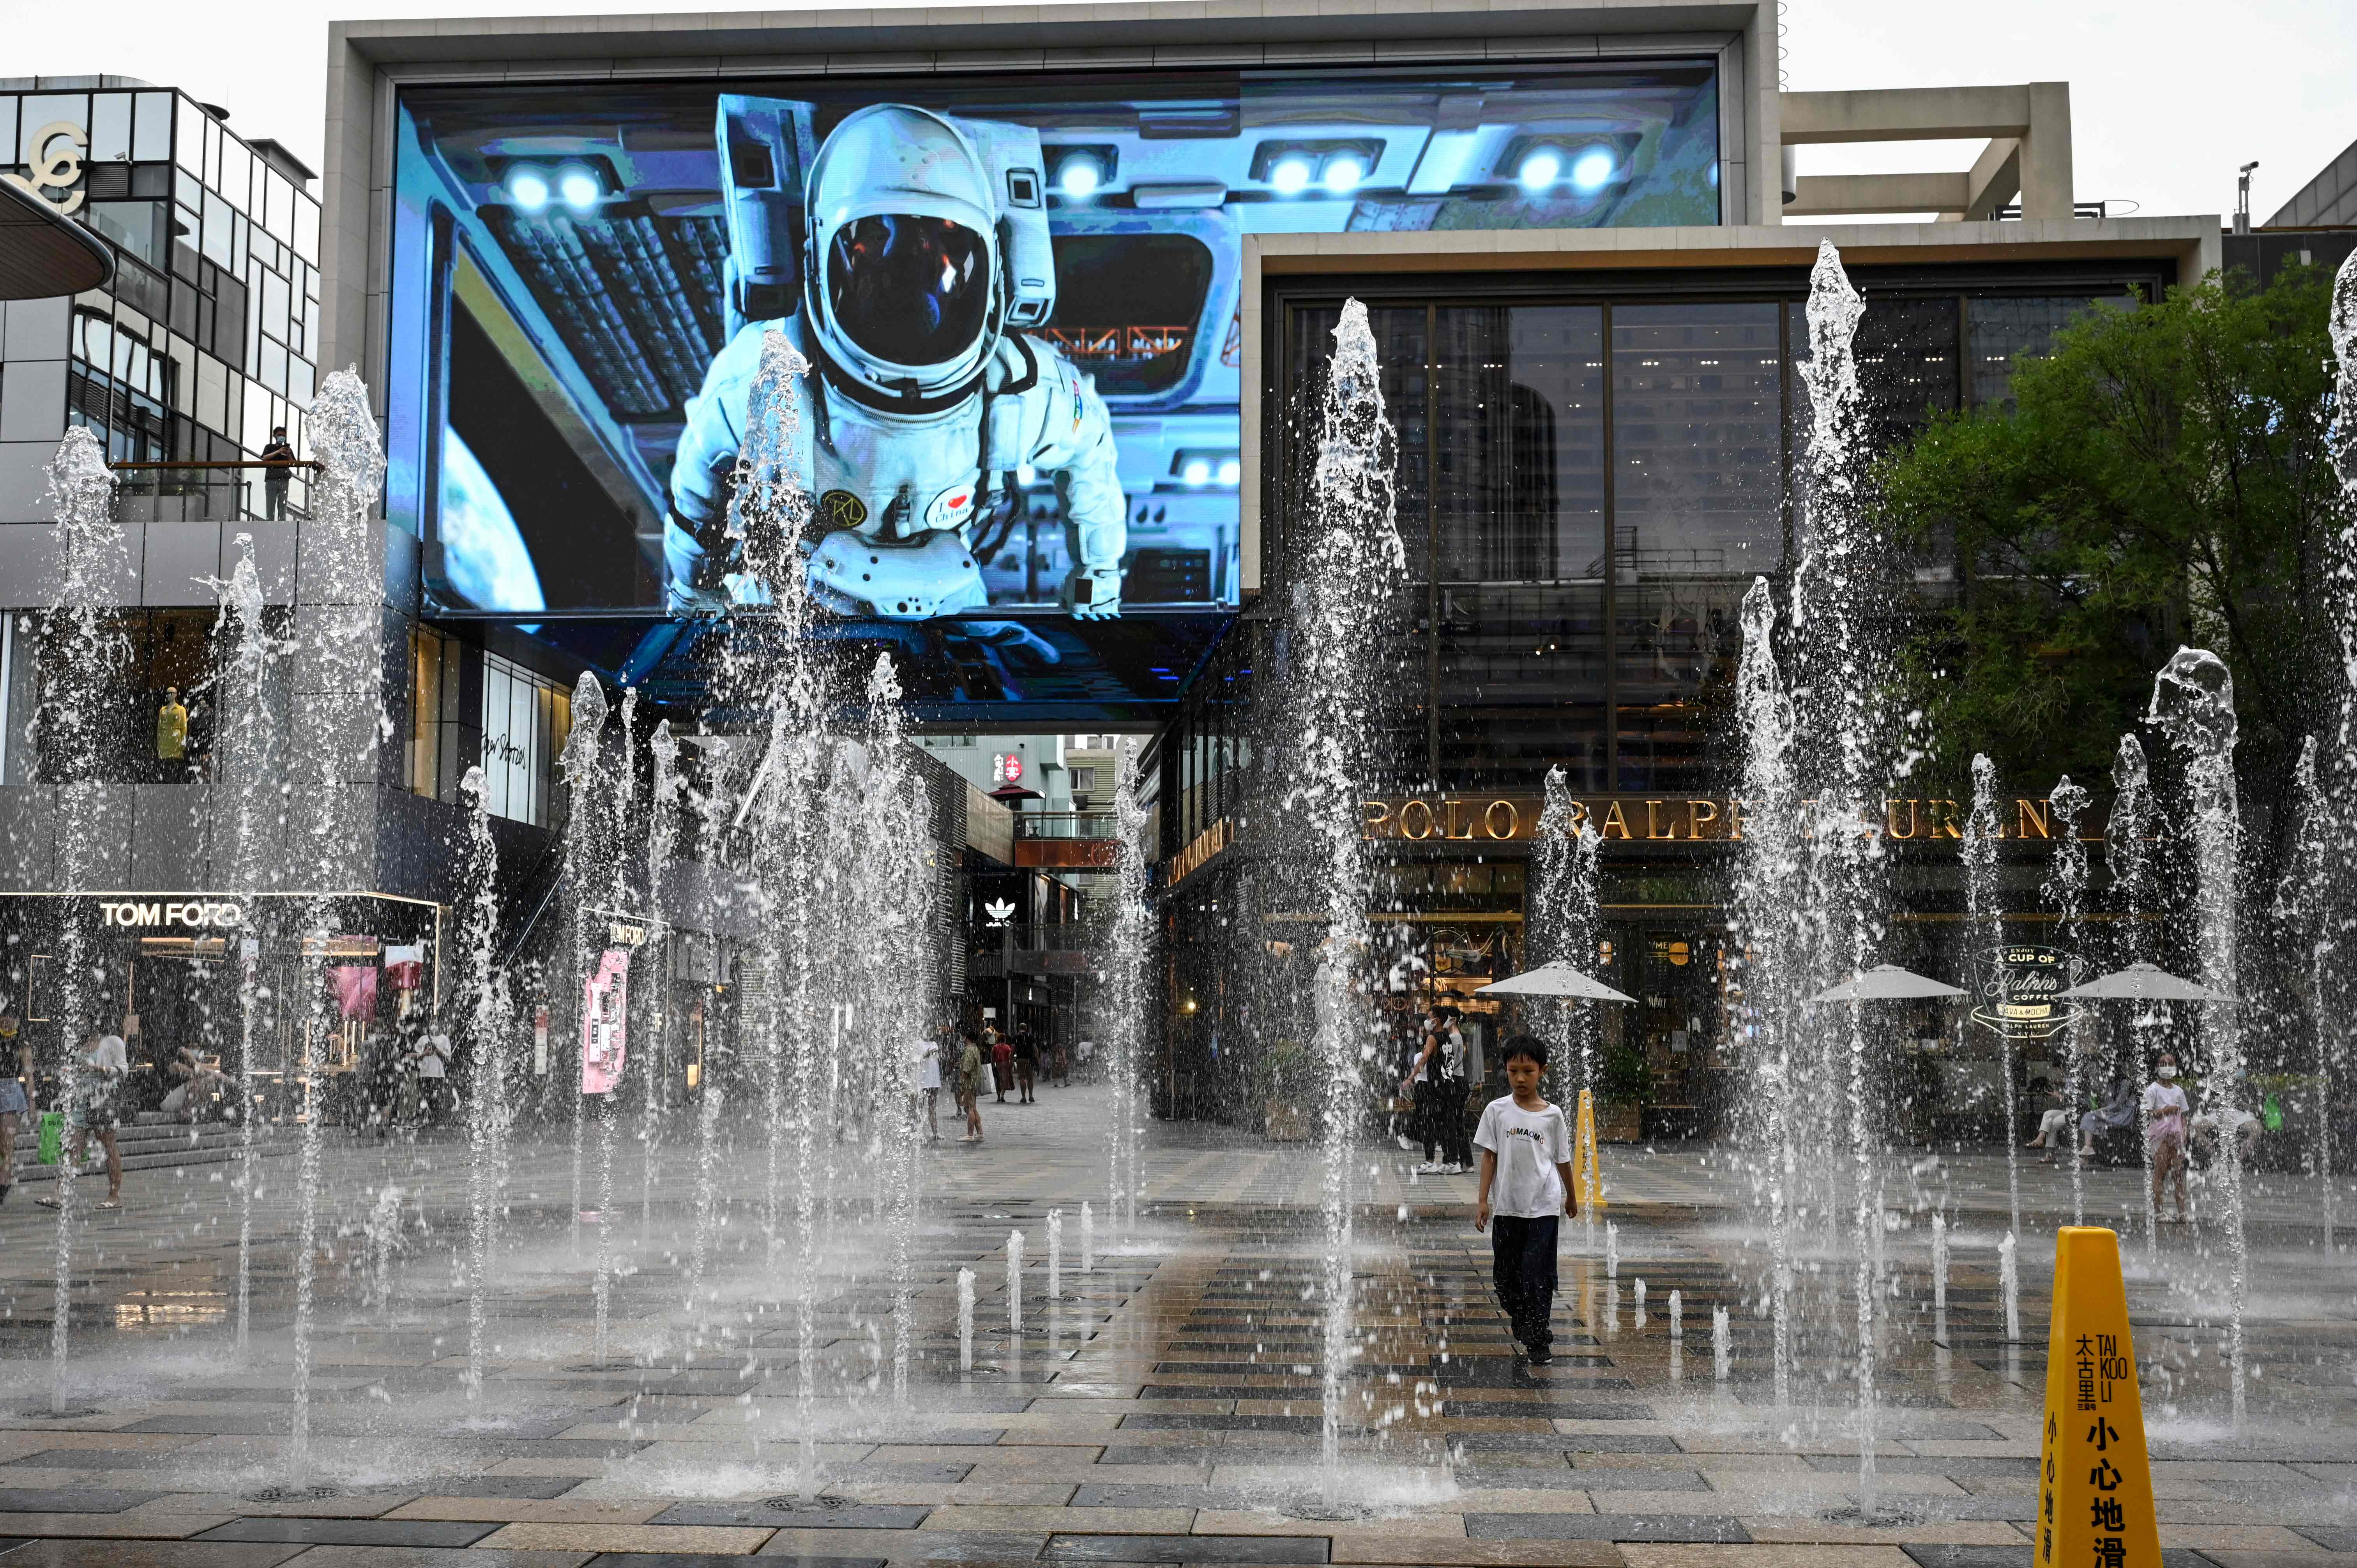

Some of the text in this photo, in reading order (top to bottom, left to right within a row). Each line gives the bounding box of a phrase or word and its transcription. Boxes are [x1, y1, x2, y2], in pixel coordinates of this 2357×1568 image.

[935, 508, 968, 523] China
[939, 502, 943, 512] I
[499, 733, 526, 770] Stories
[1362, 800, 1519, 840] POLO
[1800, 800, 2051, 839] LURN
[100, 903, 241, 926] TOM FORD
[609, 922, 644, 946] TOM FORD
[2009, 954, 2035, 962] CUP
[2038, 955, 2055, 964] OF
[2026, 1007, 2048, 1015] MOCHA
[2096, 1334, 2117, 1357] TAI
[2076, 1334, 2096, 1402] 太古里
[2100, 1357, 2127, 1380] KOO
[2101, 1380, 2112, 1402] LI
[2042, 1411, 2057, 1564] 小心地滑
[2086, 1416, 2127, 1568] 小心地滑
